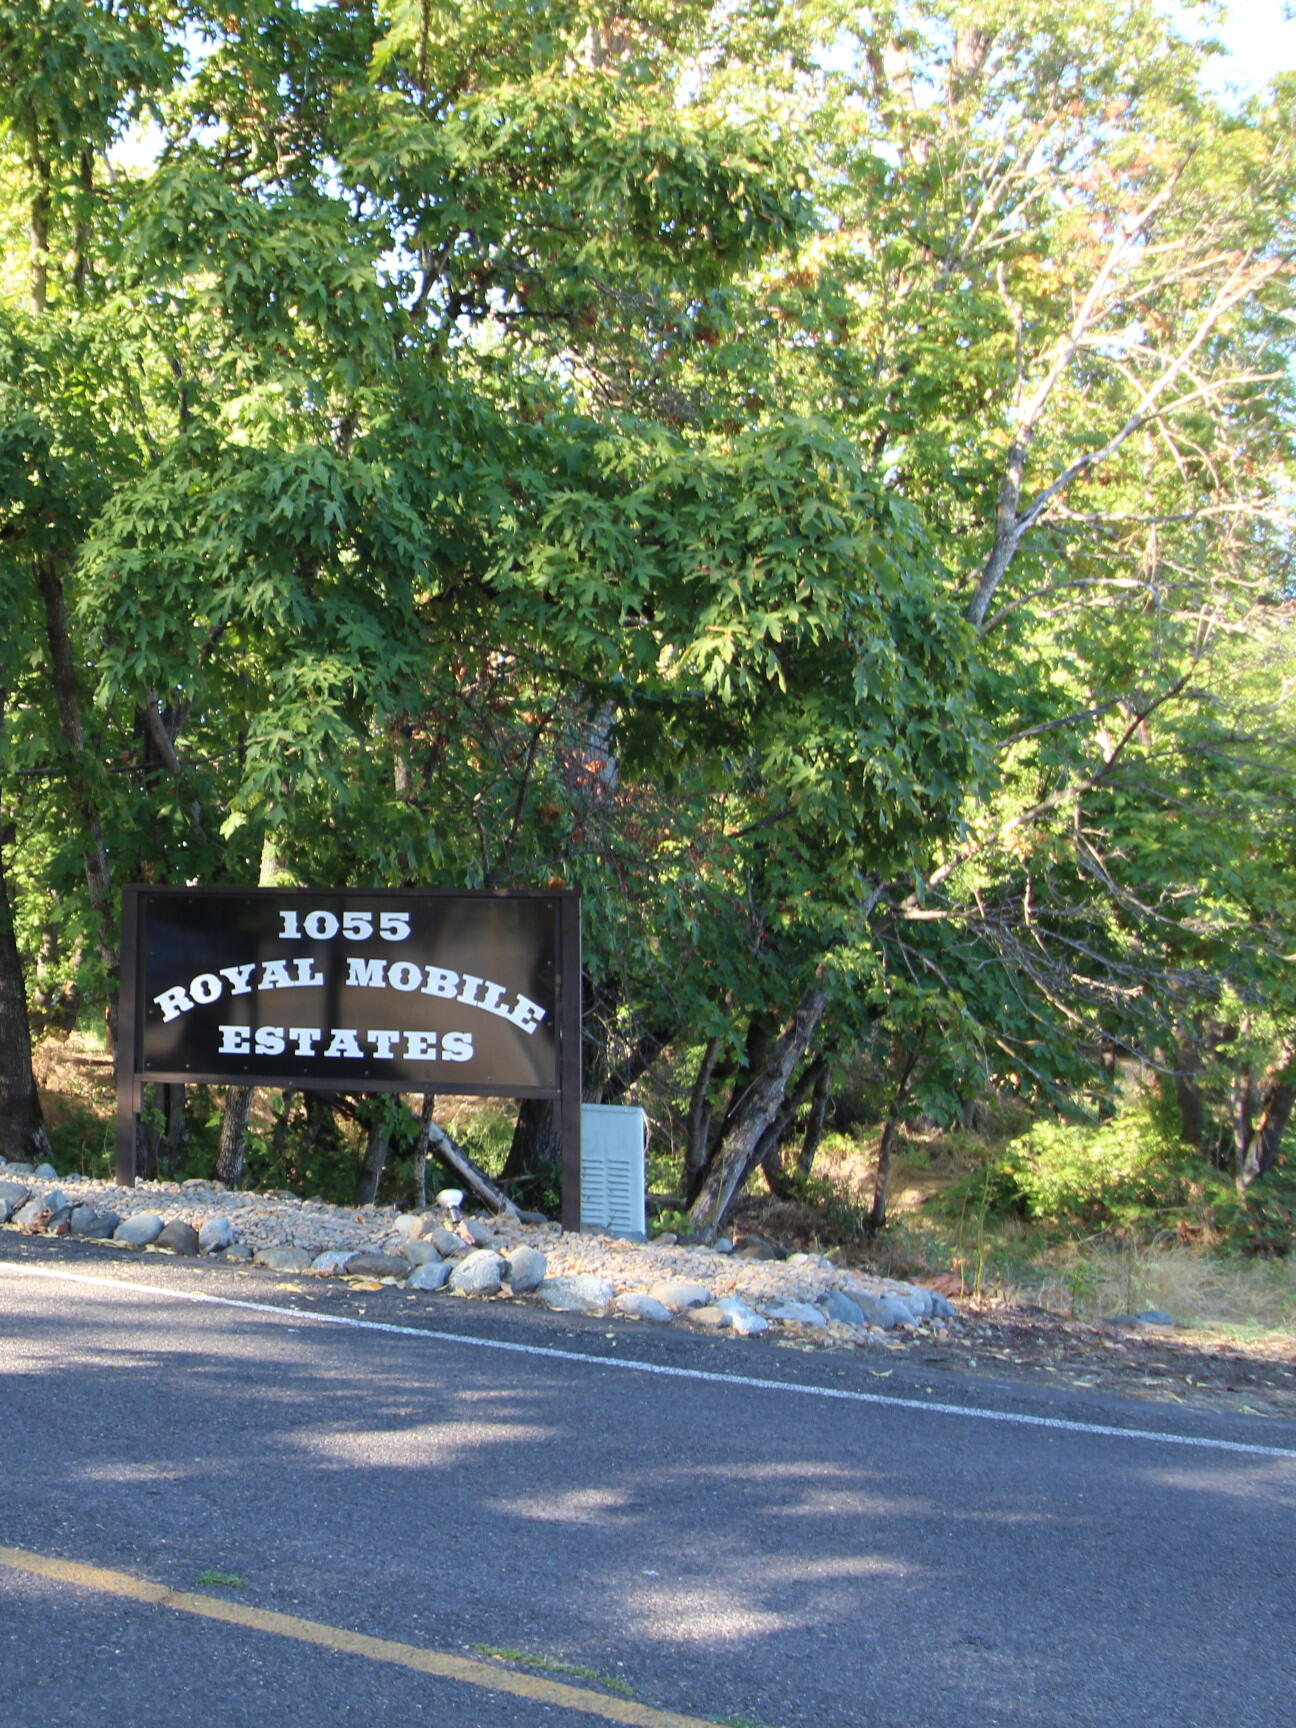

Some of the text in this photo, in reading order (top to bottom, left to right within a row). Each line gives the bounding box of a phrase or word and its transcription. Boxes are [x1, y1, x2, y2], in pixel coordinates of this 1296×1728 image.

[278, 909, 412, 942] 1055
[153, 956, 547, 1035] ROYAL MOBILE
[217, 1024, 474, 1064] ESTATES
